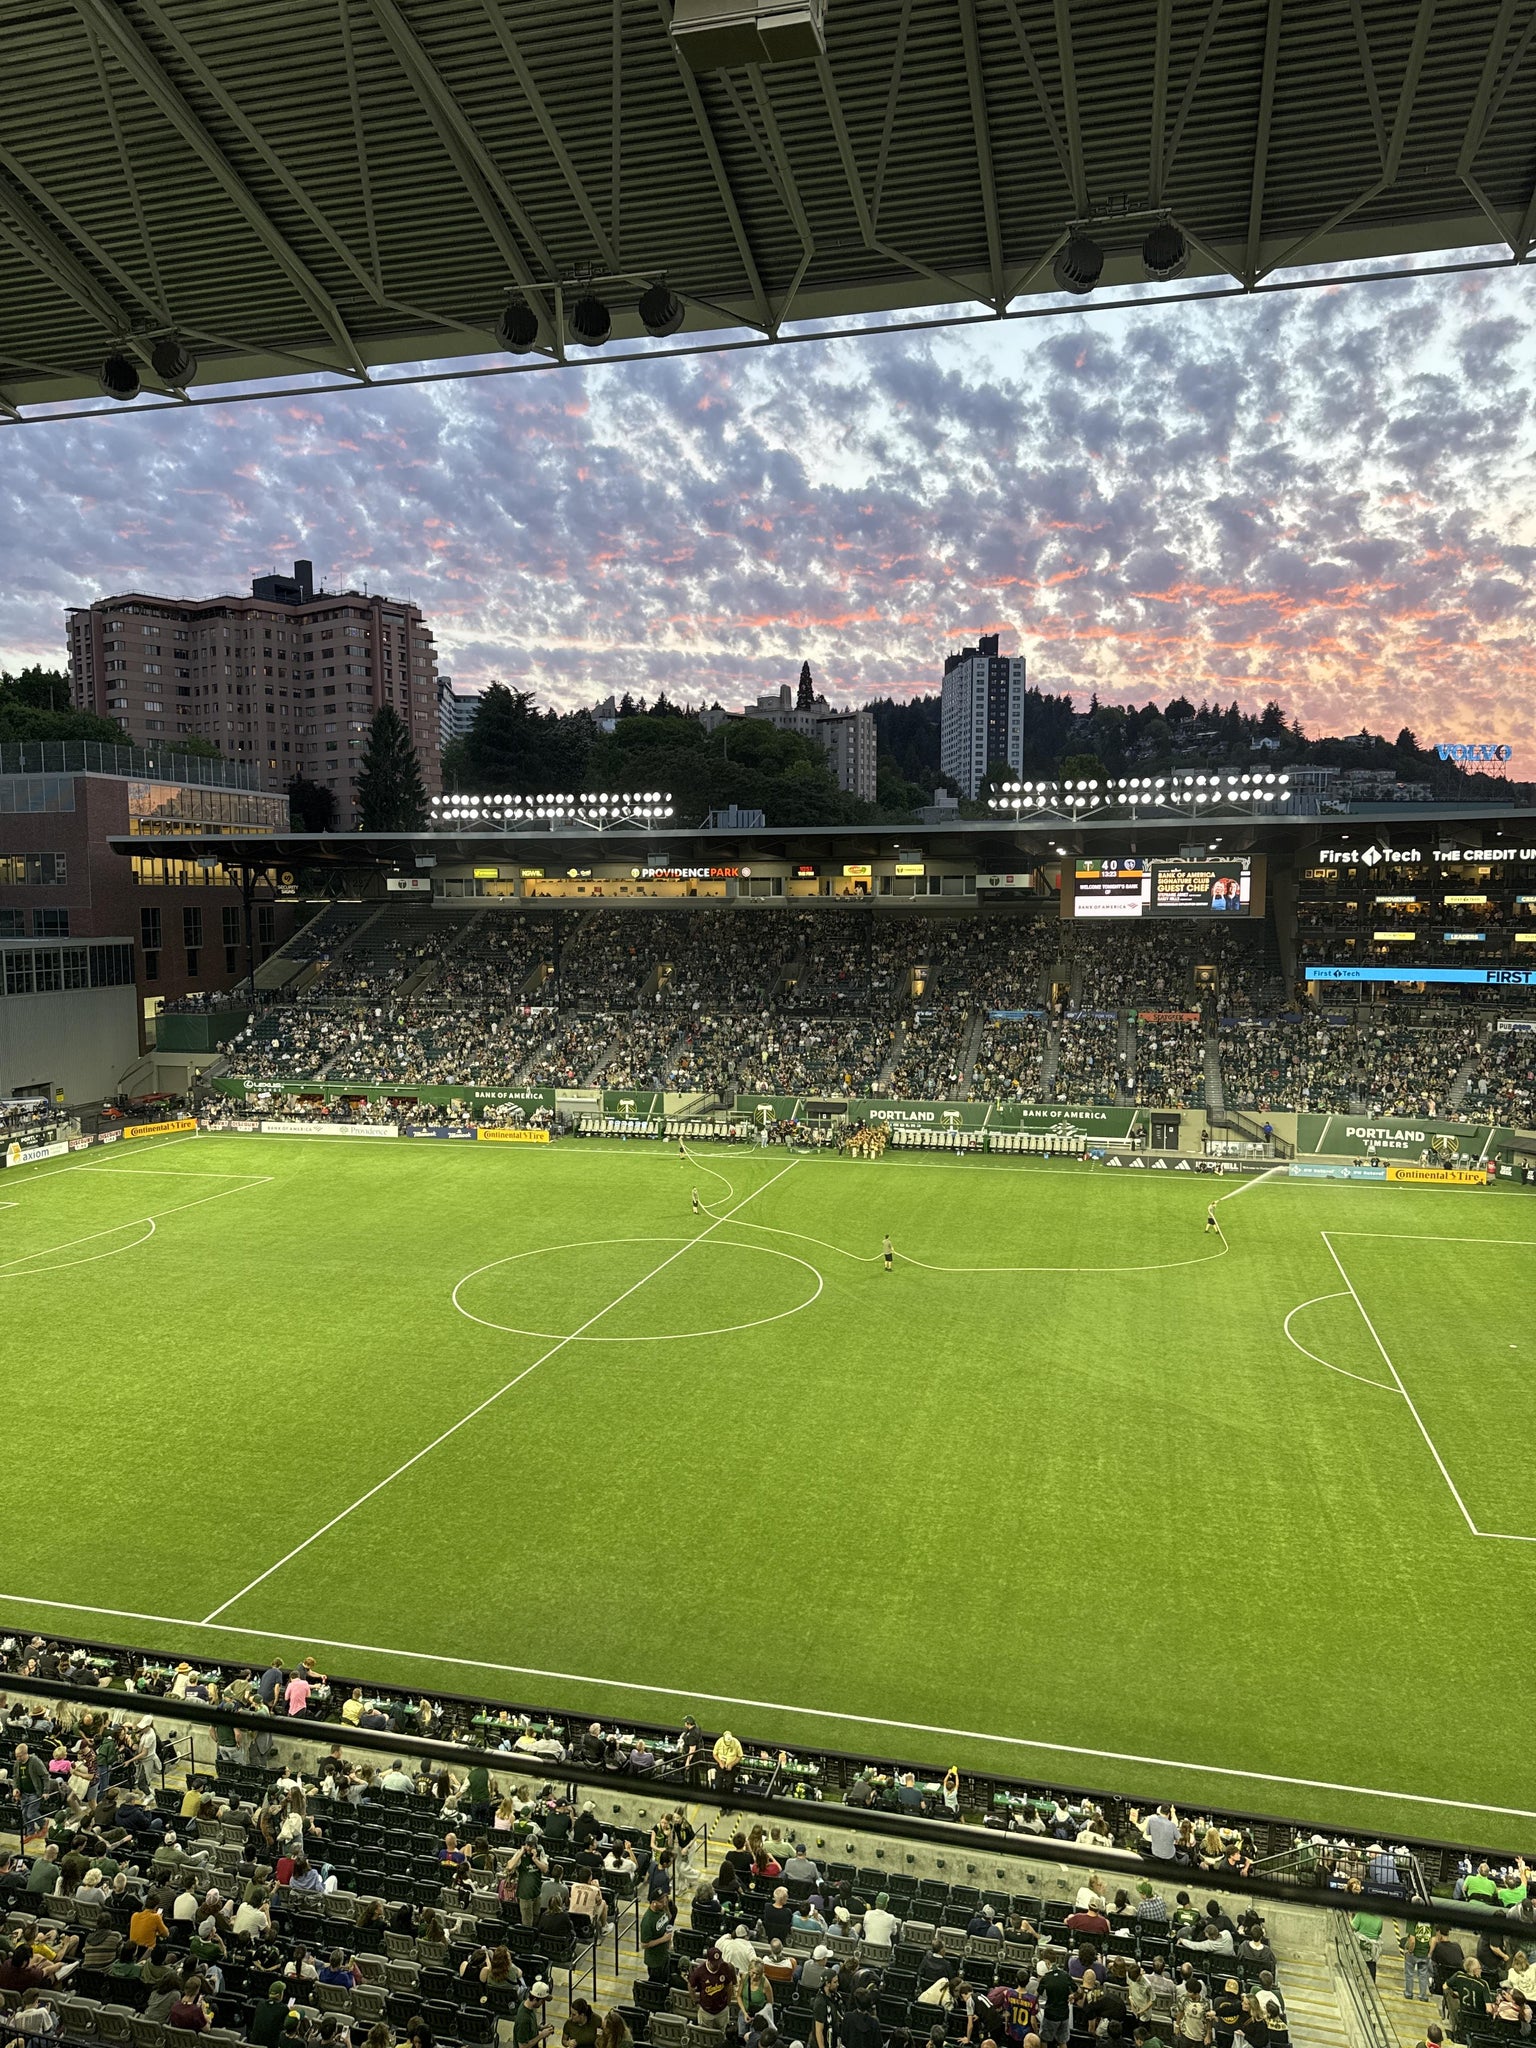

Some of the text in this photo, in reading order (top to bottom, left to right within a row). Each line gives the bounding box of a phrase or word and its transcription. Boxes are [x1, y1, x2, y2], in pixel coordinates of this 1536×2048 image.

[1435, 744, 1512, 761] VOLVO
[1320, 848, 1421, 863] First Tech
[1433, 850, 1461, 861] THE
[1463, 848, 1517, 860] CREDIT
[1102, 860, 1117, 870] 4 0
[642, 867, 739, 877] PROVIDENCE PARK
[1157, 884, 1210, 892] GUEST CHEF
[1486, 970, 1533, 983] FIRST
[869, 1109, 935, 1121] PORTLAND
[1022, 1109, 1048, 1118] BANK
[1063, 1111, 1107, 1120] AMERICA
[130, 1121, 192, 1137] Continental Tire
[350, 1127, 388, 1135] Providence
[483, 1131, 545, 1140] Continental Tire
[1345, 1126, 1426, 1142] PORTLAND
[1362, 1139, 1409, 1149] TIMBERS
[22, 1148, 50, 1161] axiom
[1395, 1169, 1480, 1181] Continental Tire
[576, 1889, 589, 1906] 11
[1462, 1987, 1477, 2009] 21
[1012, 2006, 1029, 2026] 10
